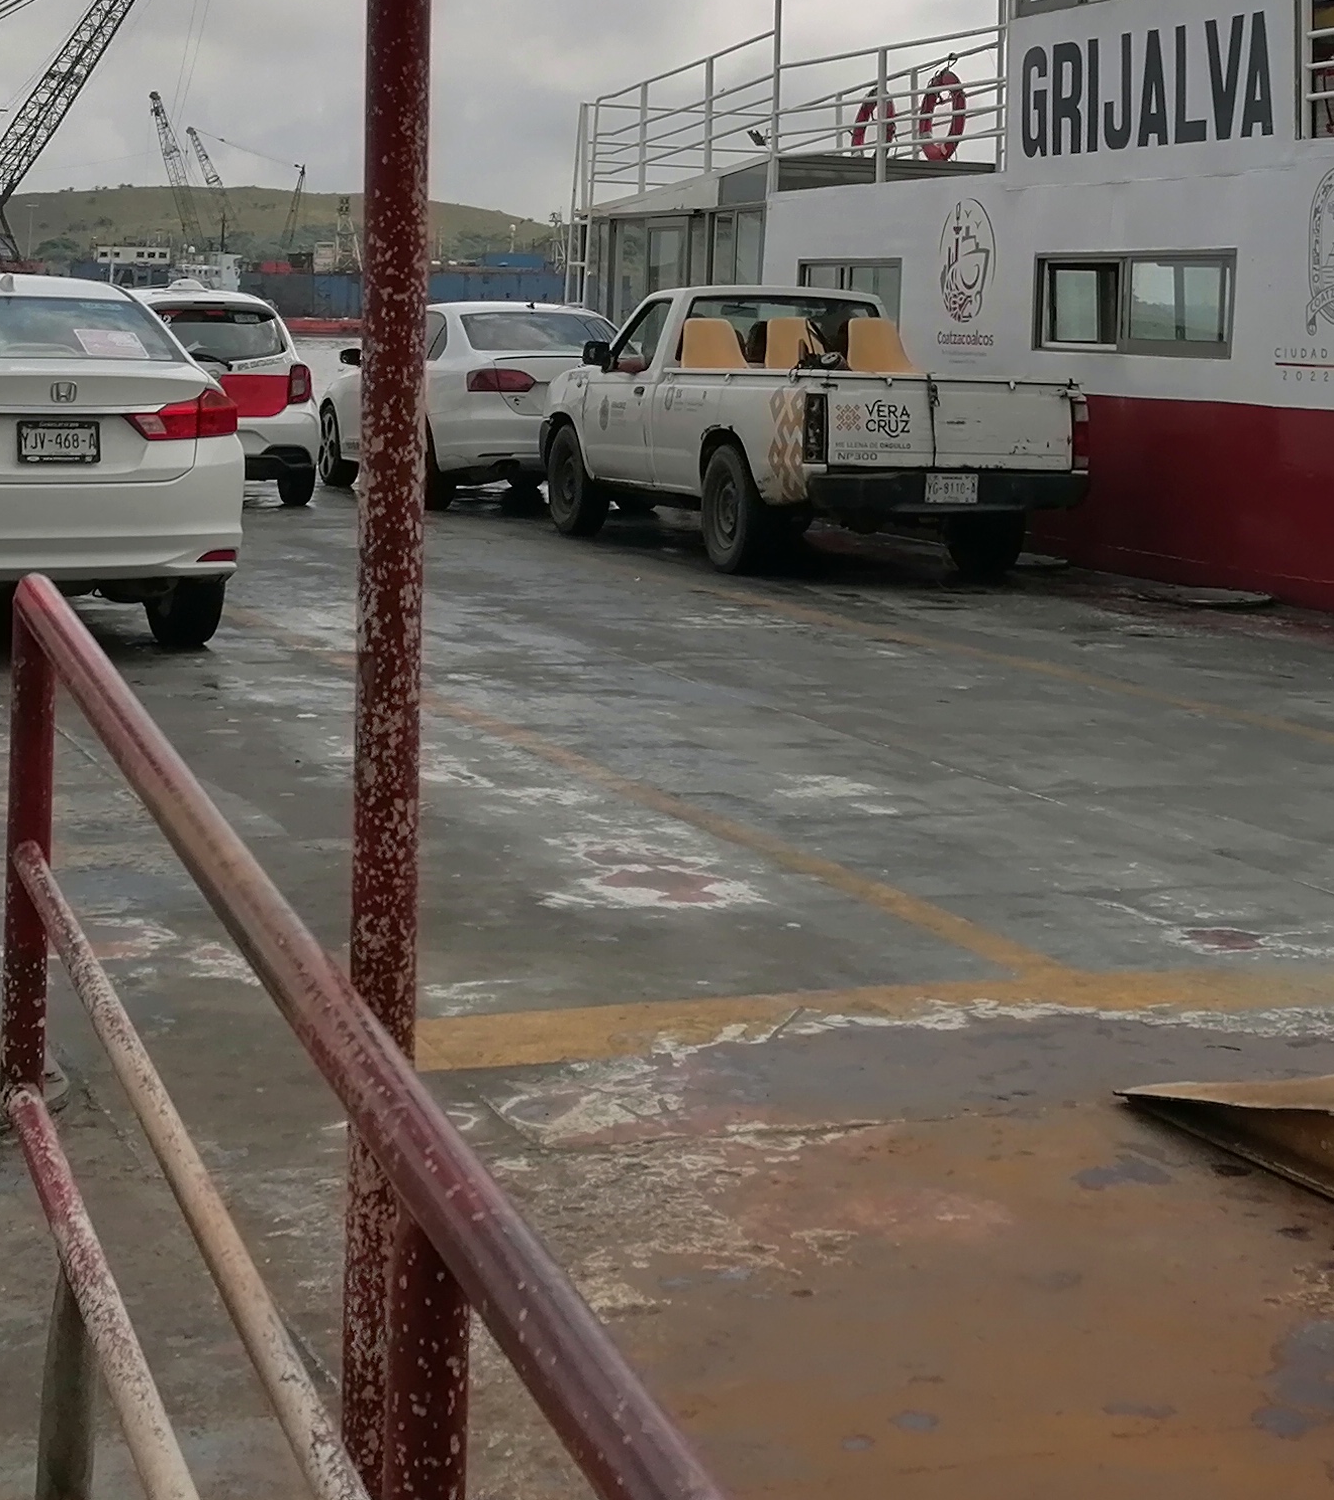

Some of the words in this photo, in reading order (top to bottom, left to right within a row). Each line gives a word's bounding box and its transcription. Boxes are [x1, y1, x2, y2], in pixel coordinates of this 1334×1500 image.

[1022, 10, 1274, 158] GRIJALVA
[937, 329, 994, 346] Coatzacoalcos
[1274, 347, 1328, 359] CIUDAD
[865, 399, 911, 419] VERA
[865, 418, 911, 438] CRUZ
[21, 432, 97, 450] YJV-468-A
[837, 452, 878, 460] NP300
